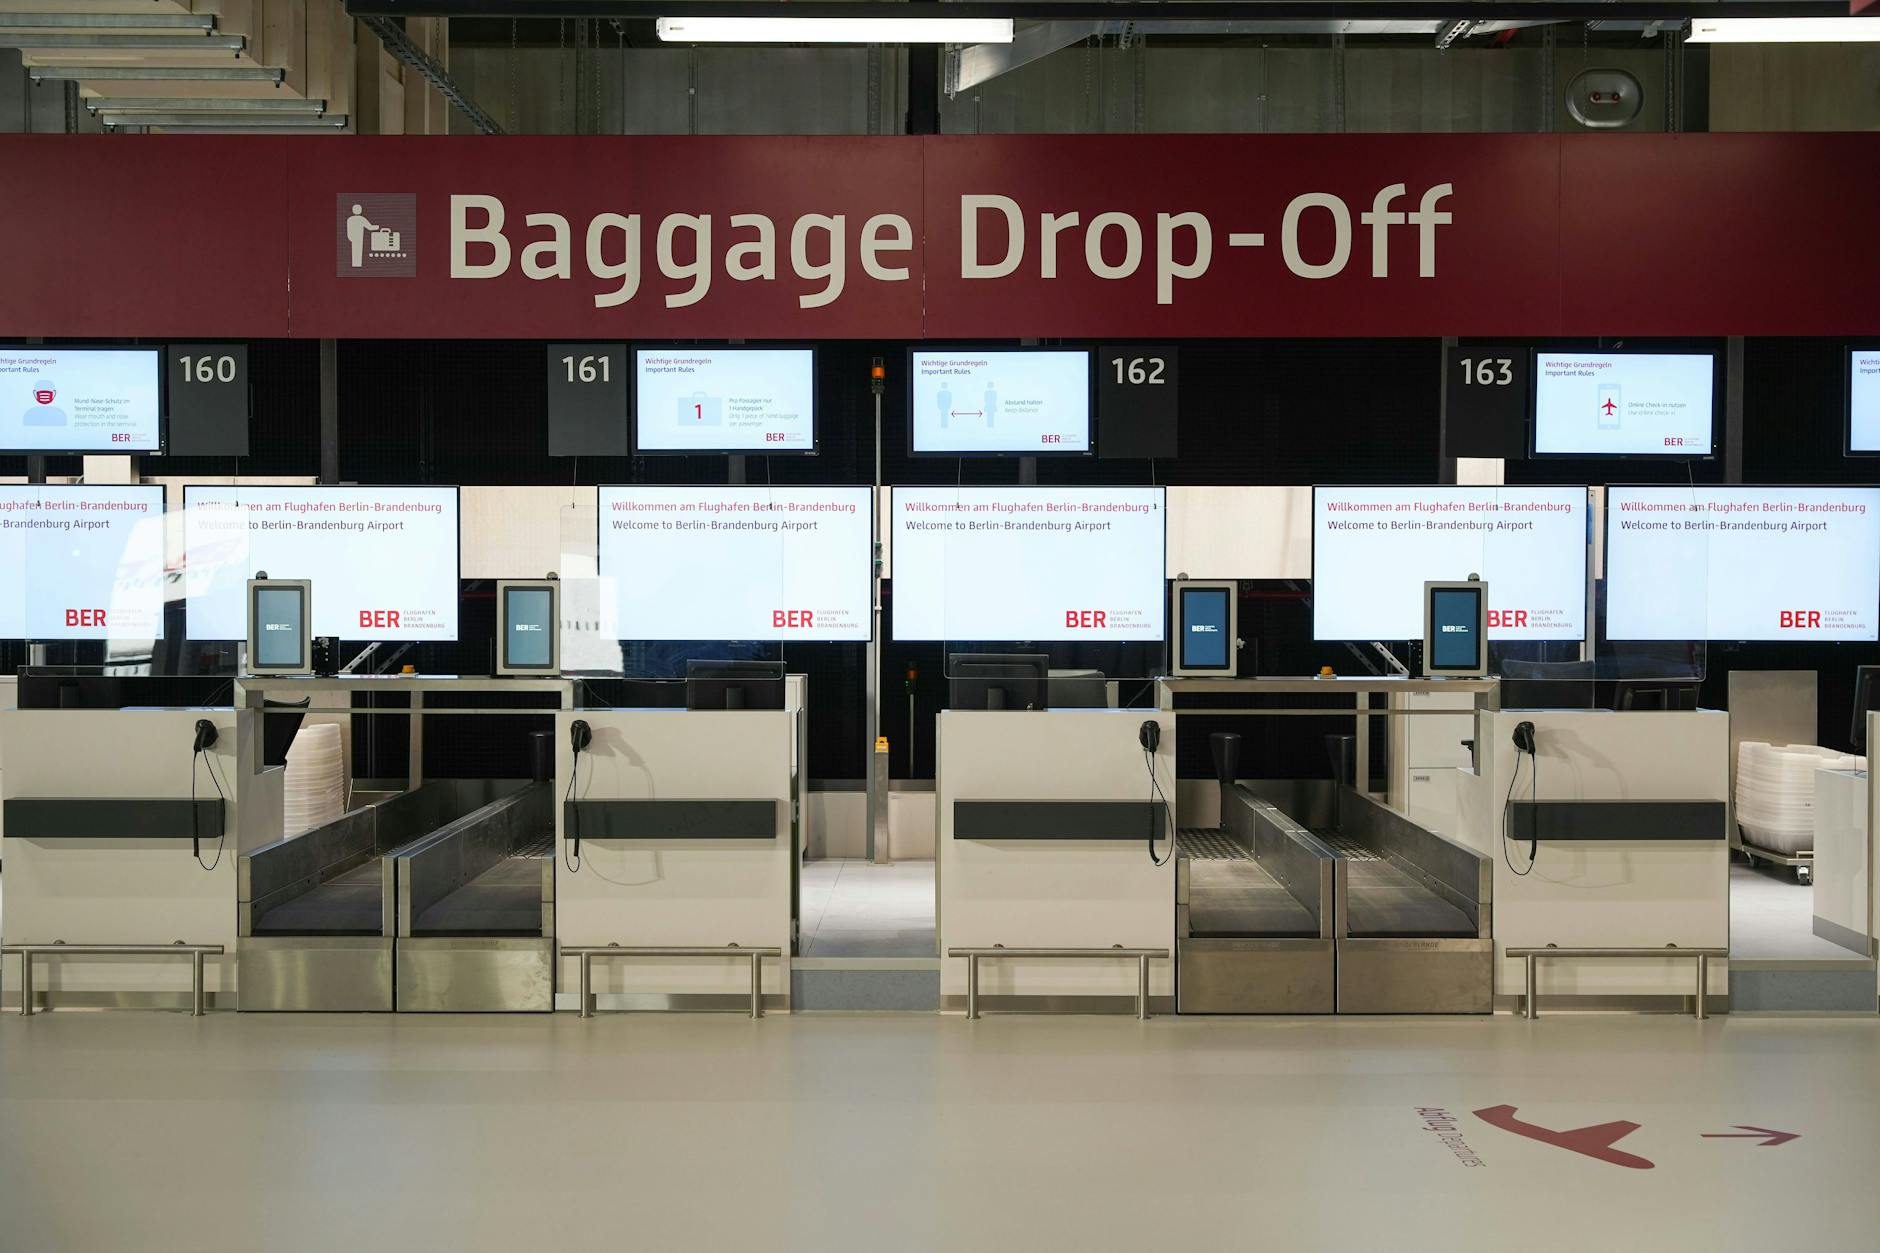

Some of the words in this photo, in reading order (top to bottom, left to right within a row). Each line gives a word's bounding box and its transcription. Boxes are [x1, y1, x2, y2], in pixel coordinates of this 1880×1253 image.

[450, 194, 913, 308] Baggage
[961, 182, 1453, 305] Drop-Off
[645, 358, 672, 366] Wichtige
[673, 357, 712, 366] Grundregeln
[921, 360, 949, 368] Wichtige
[949, 359, 988, 368] Grundregeln
[1545, 361, 1573, 369] Wichtige
[1573, 361, 1612, 370] Grundregeln
[179, 355, 236, 383] 160
[562, 355, 610, 383] 161
[645, 366, 677, 375] Important
[921, 368, 953, 376] Important
[1111, 357, 1165, 385] 162
[1460, 358, 1513, 386] 163
[1545, 369, 1577, 378] Important
[694, 404, 702, 420] 1
[111, 433, 131, 442] BER
[766, 432, 785, 442] BER
[1041, 434, 1061, 443] BER
[1664, 437, 1684, 446] BER
[44, 501, 148, 513] Berlin-Brandenburg
[265, 503, 282, 512] am
[284, 501, 336, 514] Flughafen
[337, 501, 442, 515] Berlin-Brandenburg
[611, 501, 677, 512] Willkommen
[679, 503, 696, 512] am
[698, 501, 750, 514] Flughafen
[752, 501, 856, 515] Berlin-Brandenburg
[904, 501, 971, 512] Willkommen
[972, 504, 989, 512] am
[991, 502, 1044, 515] Flughafen
[1046, 502, 1150, 515] Berlin-Brandenburg
[1327, 501, 1393, 512] Willkommen
[1394, 503, 1411, 512] am
[1413, 501, 1466, 514] Flughafen
[1468, 501, 1571, 514] Berlin-Brandenburg
[1620, 501, 1686, 512] Willkommen
[1688, 503, 1705, 512] am
[1707, 501, 1760, 514] Flughafen
[1762, 501, 1866, 514] Berlin-Brandenburg
[73, 519, 110, 532] Airport
[248, 520, 259, 530] to
[261, 520, 365, 533] Berlin-Brandenburg
[366, 520, 404, 533] Airport
[612, 520, 660, 530] Welcome
[661, 520, 673, 530] to
[675, 519, 779, 533] Berlin-Brandenburg
[780, 520, 818, 533] Airport
[905, 520, 953, 531] Welcome
[954, 521, 966, 531] to
[968, 520, 1072, 533] Berlin-Brandenburg
[1074, 520, 1111, 533] Airport
[1327, 520, 1375, 530] Welcome
[1376, 520, 1388, 530] to
[1390, 520, 1494, 533] Berlin-Brandenburg
[1496, 520, 1534, 533] Airport
[1620, 520, 1668, 530] Welcome
[1670, 520, 1682, 530] to
[1684, 520, 1788, 533] Berlin-Brandenburg
[1790, 520, 1828, 533] Airport
[65, 609, 107, 627] BER
[359, 610, 400, 628] BER
[773, 610, 813, 628] BER
[1065, 610, 1106, 628] BER
[1487, 610, 1527, 628] BER
[1780, 610, 1820, 628] BER
[1413, 1106, 1458, 1131] Abflug
[1436, 1132, 1487, 1167] Departures
